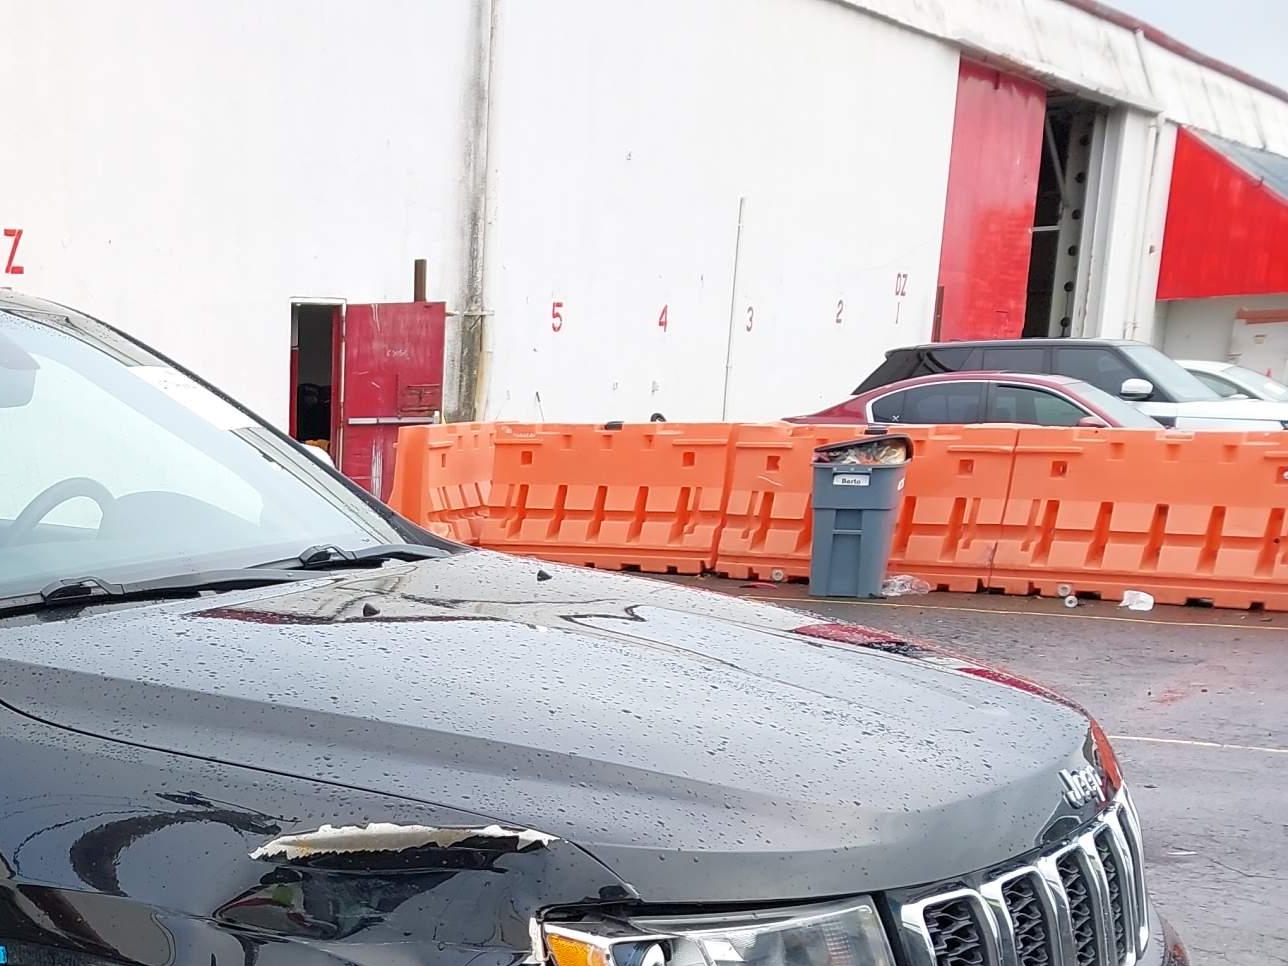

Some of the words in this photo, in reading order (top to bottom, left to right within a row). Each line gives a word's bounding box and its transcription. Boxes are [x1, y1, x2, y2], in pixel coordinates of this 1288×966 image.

[552, 302, 563, 332] 5
[658, 304, 668, 332] 4
[746, 306, 754, 332] 3
[836, 299, 844, 324] 2
[1057, 765, 1106, 809] Jeep
